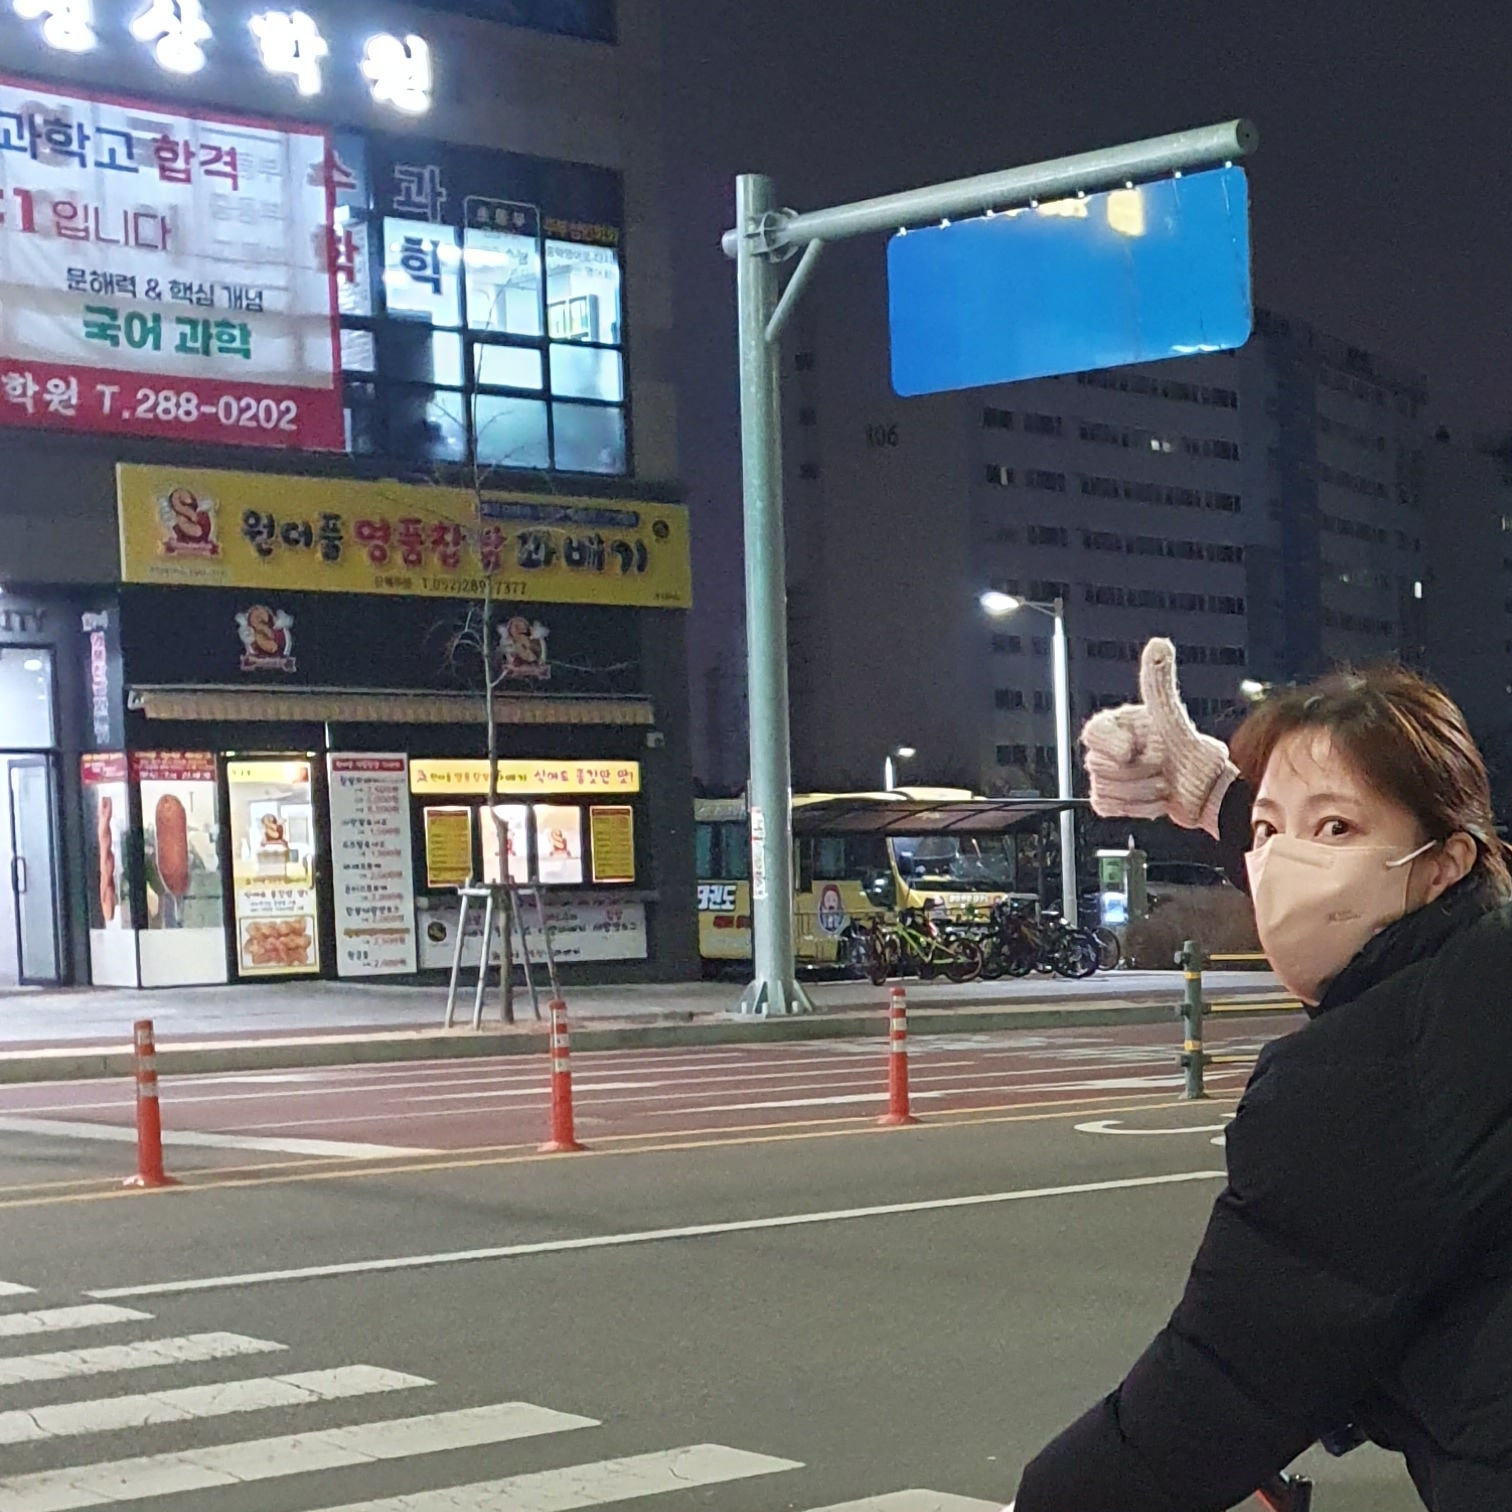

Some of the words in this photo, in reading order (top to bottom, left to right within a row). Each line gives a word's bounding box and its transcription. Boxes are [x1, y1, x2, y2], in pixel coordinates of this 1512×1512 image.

[153, 133, 239, 193] 합격
[53, 200, 173, 251] 입니다
[392, 163, 447, 296] 과학
[66, 267, 137, 299] 문해력
[144, 278, 163, 301] &
[83, 303, 163, 353] 국어
[174, 315, 252, 360] 과학
[1, 370, 79, 418] 학원
